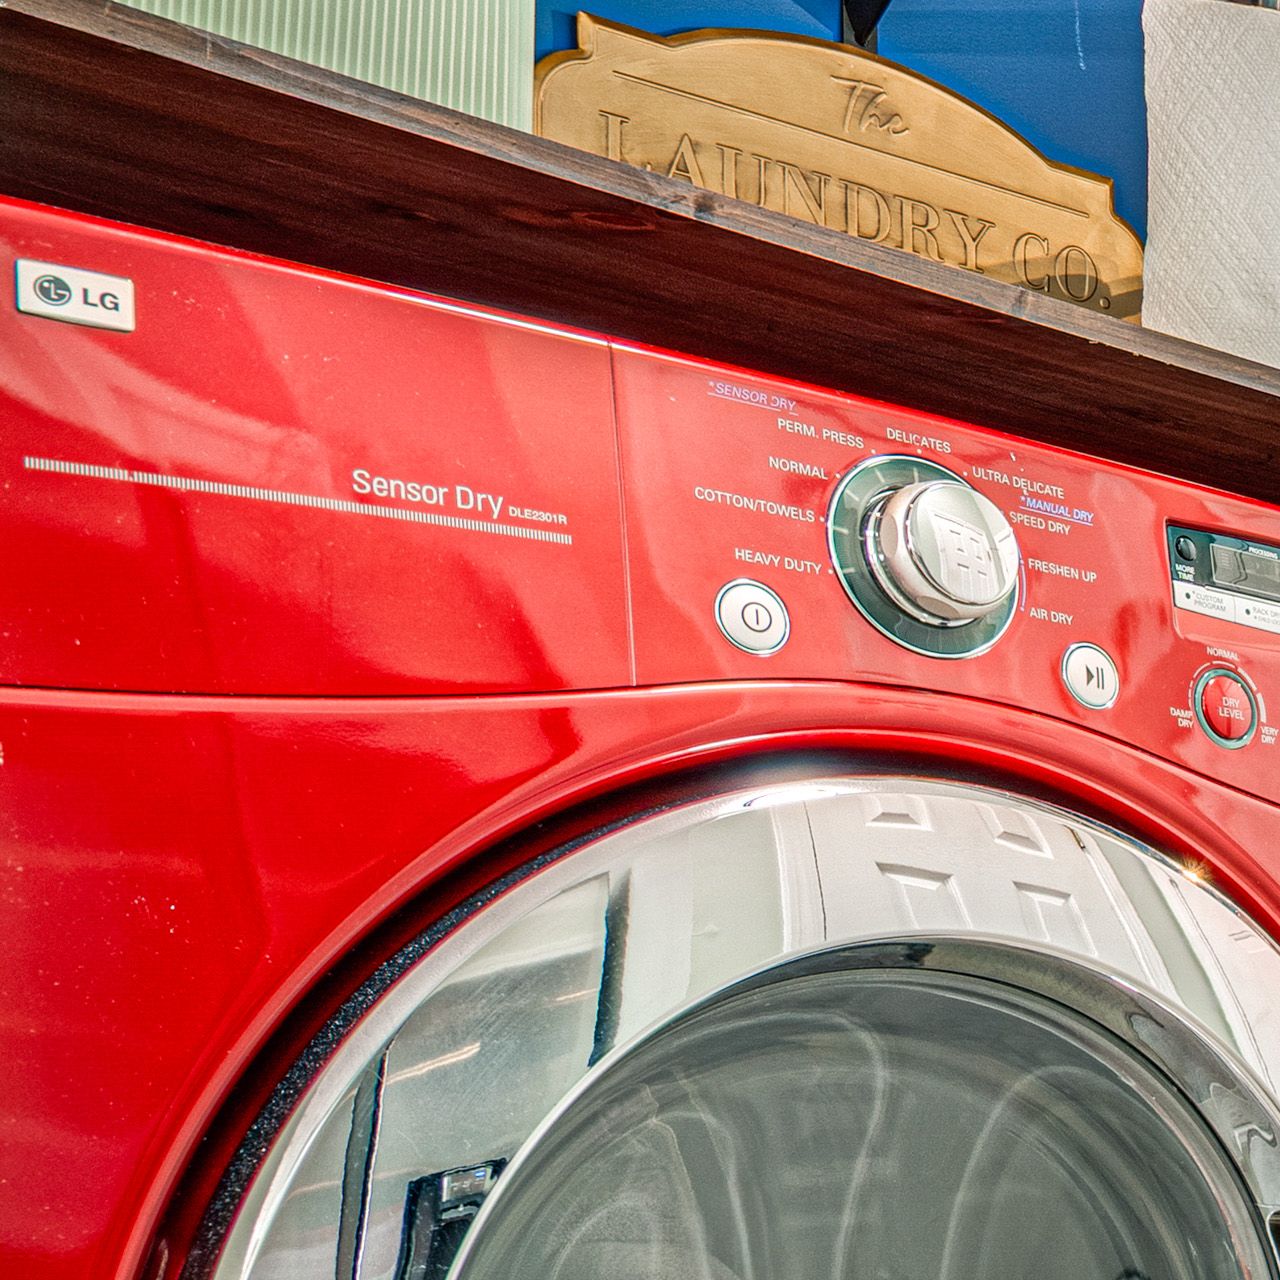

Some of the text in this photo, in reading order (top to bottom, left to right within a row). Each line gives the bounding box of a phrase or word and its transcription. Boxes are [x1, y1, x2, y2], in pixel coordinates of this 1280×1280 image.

[830, 75, 909, 135] The
[599, 110, 1111, 310] LAUNDRY CO.
[83, 288, 119, 311] LG
[777, 418, 864, 449] PERM. PRESS
[886, 427, 952, 453] DELICATES
[768, 456, 828, 480] NORMAL
[972, 466, 1065, 499] ULTRA DELICATE
[352, 468, 568, 525] Sensor Dry DLE2301R
[694, 486, 815, 522] COTTON/TOWELS
[1009, 511, 1071, 536] SPEED DRY
[1073, 509, 1094, 524] DRY
[735, 547, 822, 575] HEAVY DUTY
[1028, 558, 1097, 583] FRESHEN UP
[1029, 606, 1073, 625] AIR DRY
[1206, 646, 1239, 660] NORMAL
[1170, 707, 1193, 719] DAMP
[1219, 707, 1244, 720] LEVEL
[1222, 697, 1239, 708] DRY
[1178, 718, 1194, 728] DRY
[1261, 726, 1279, 736] VERY
[1261, 735, 1275, 745] DRY
